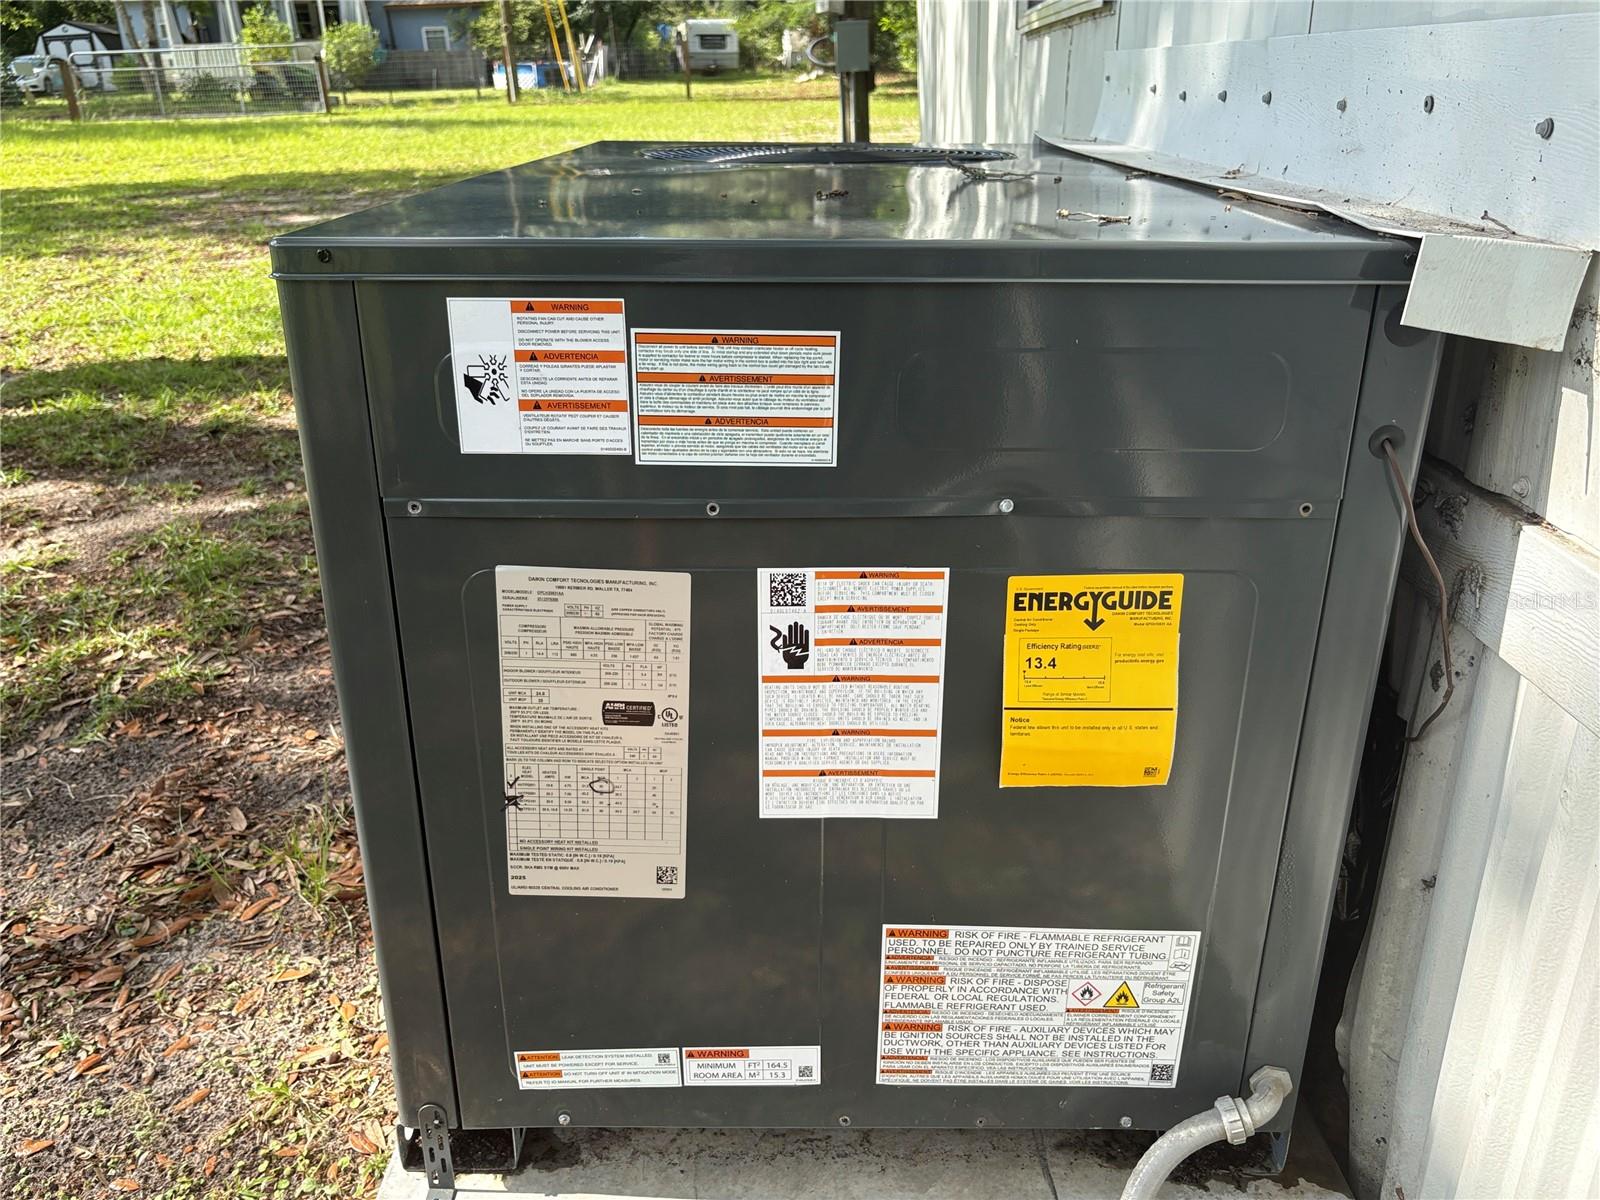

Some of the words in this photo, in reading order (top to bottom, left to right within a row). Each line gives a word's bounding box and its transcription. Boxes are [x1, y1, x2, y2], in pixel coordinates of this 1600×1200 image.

[1014, 589, 1172, 613] ENERGYGUIDE
[1026, 657, 1056, 669] 13.4
[665, 711, 674, 719] UL
[898, 930, 948, 938] WARNING
[1030, 933, 1090, 941] FLAMMABLE
[1093, 934, 1166, 943] REFRIGERANT
[955, 940, 1006, 948] REPAIRED
[996, 949, 1051, 957] PUNCTURE
[1054, 950, 1126, 959] REFRIGERANT
[946, 1003, 1015, 1011] REFRIGERANT
